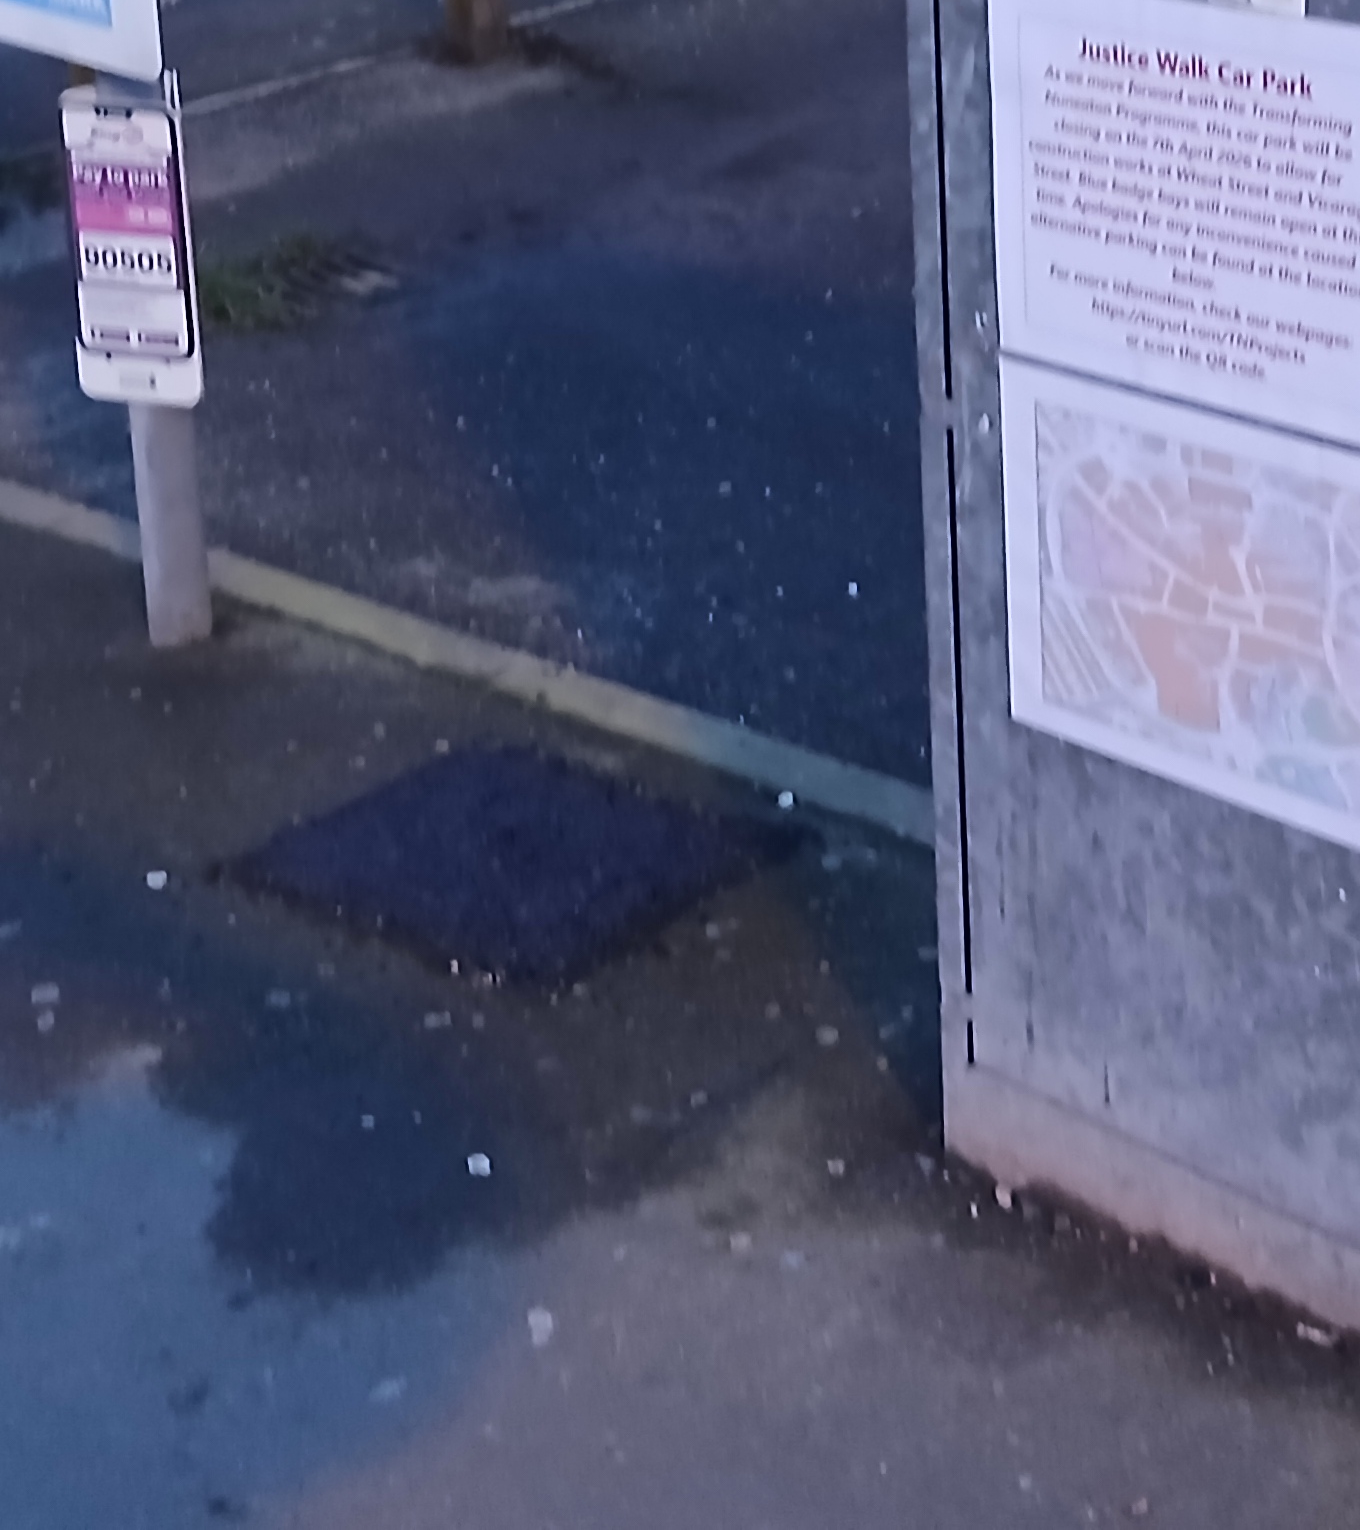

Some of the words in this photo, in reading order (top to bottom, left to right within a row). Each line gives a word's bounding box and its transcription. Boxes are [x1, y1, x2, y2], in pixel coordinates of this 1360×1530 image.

[1044, 64, 1060, 80] As
[1128, 79, 1183, 102] forward
[1188, 92, 1218, 110] with
[1223, 96, 1246, 114] the
[1253, 101, 1352, 138] Transforming
[1079, 36, 1148, 68] Justice
[1156, 48, 1209, 81] Walk
[1218, 60, 1253, 88] Car
[1263, 66, 1313, 100] Park
[1045, 89, 1112, 116] Nuneaton
[1206, 120, 1232, 139] this
[1263, 134, 1296, 152] park
[1303, 141, 1330, 157] will
[1335, 142, 1353, 162] be
[1054, 118, 1100, 143] closing
[1126, 130, 1148, 147] the
[1178, 139, 1212, 161] April
[1257, 155, 1271, 171] to
[1275, 160, 1317, 181] allow
[1321, 168, 1342, 188] for
[1028, 140, 1109, 166] construction
[1114, 157, 1153, 175] works
[1157, 164, 1172, 178] at
[1176, 165, 1222, 189] Wheat
[1228, 174, 1269, 201] Street
[1274, 189, 1303, 207] and
[1078, 170, 1107, 188] Blue
[1112, 176, 1154, 203] badge
[1158, 186, 1189, 210] bays
[1194, 197, 1220, 215] will
[1224, 204, 1276, 226] remain
[1280, 216, 1317, 235] open
[1322, 223, 1337, 240] at
[1030, 213, 1101, 239] alternative
[1105, 230, 1157, 255] parking
[1162, 243, 1186, 259] can
[1191, 245, 1208, 264] be
[1212, 250, 1255, 274] found
[1259, 263, 1272, 278] at
[1279, 266, 1302, 285] the
[1072, 194, 1138, 221] Apologies
[1142, 209, 1160, 229] for
[1166, 218, 1192, 238] any
[1196, 222, 1299, 259] inconvenience
[1050, 262, 1069, 281] For
[1074, 273, 1108, 291] more
[1202, 300, 1241, 319] check
[1144, 338, 1175, 356] scan
[1179, 345, 1201, 362] the
[1206, 351, 1228, 371] QR
[1232, 360, 1265, 381] code
